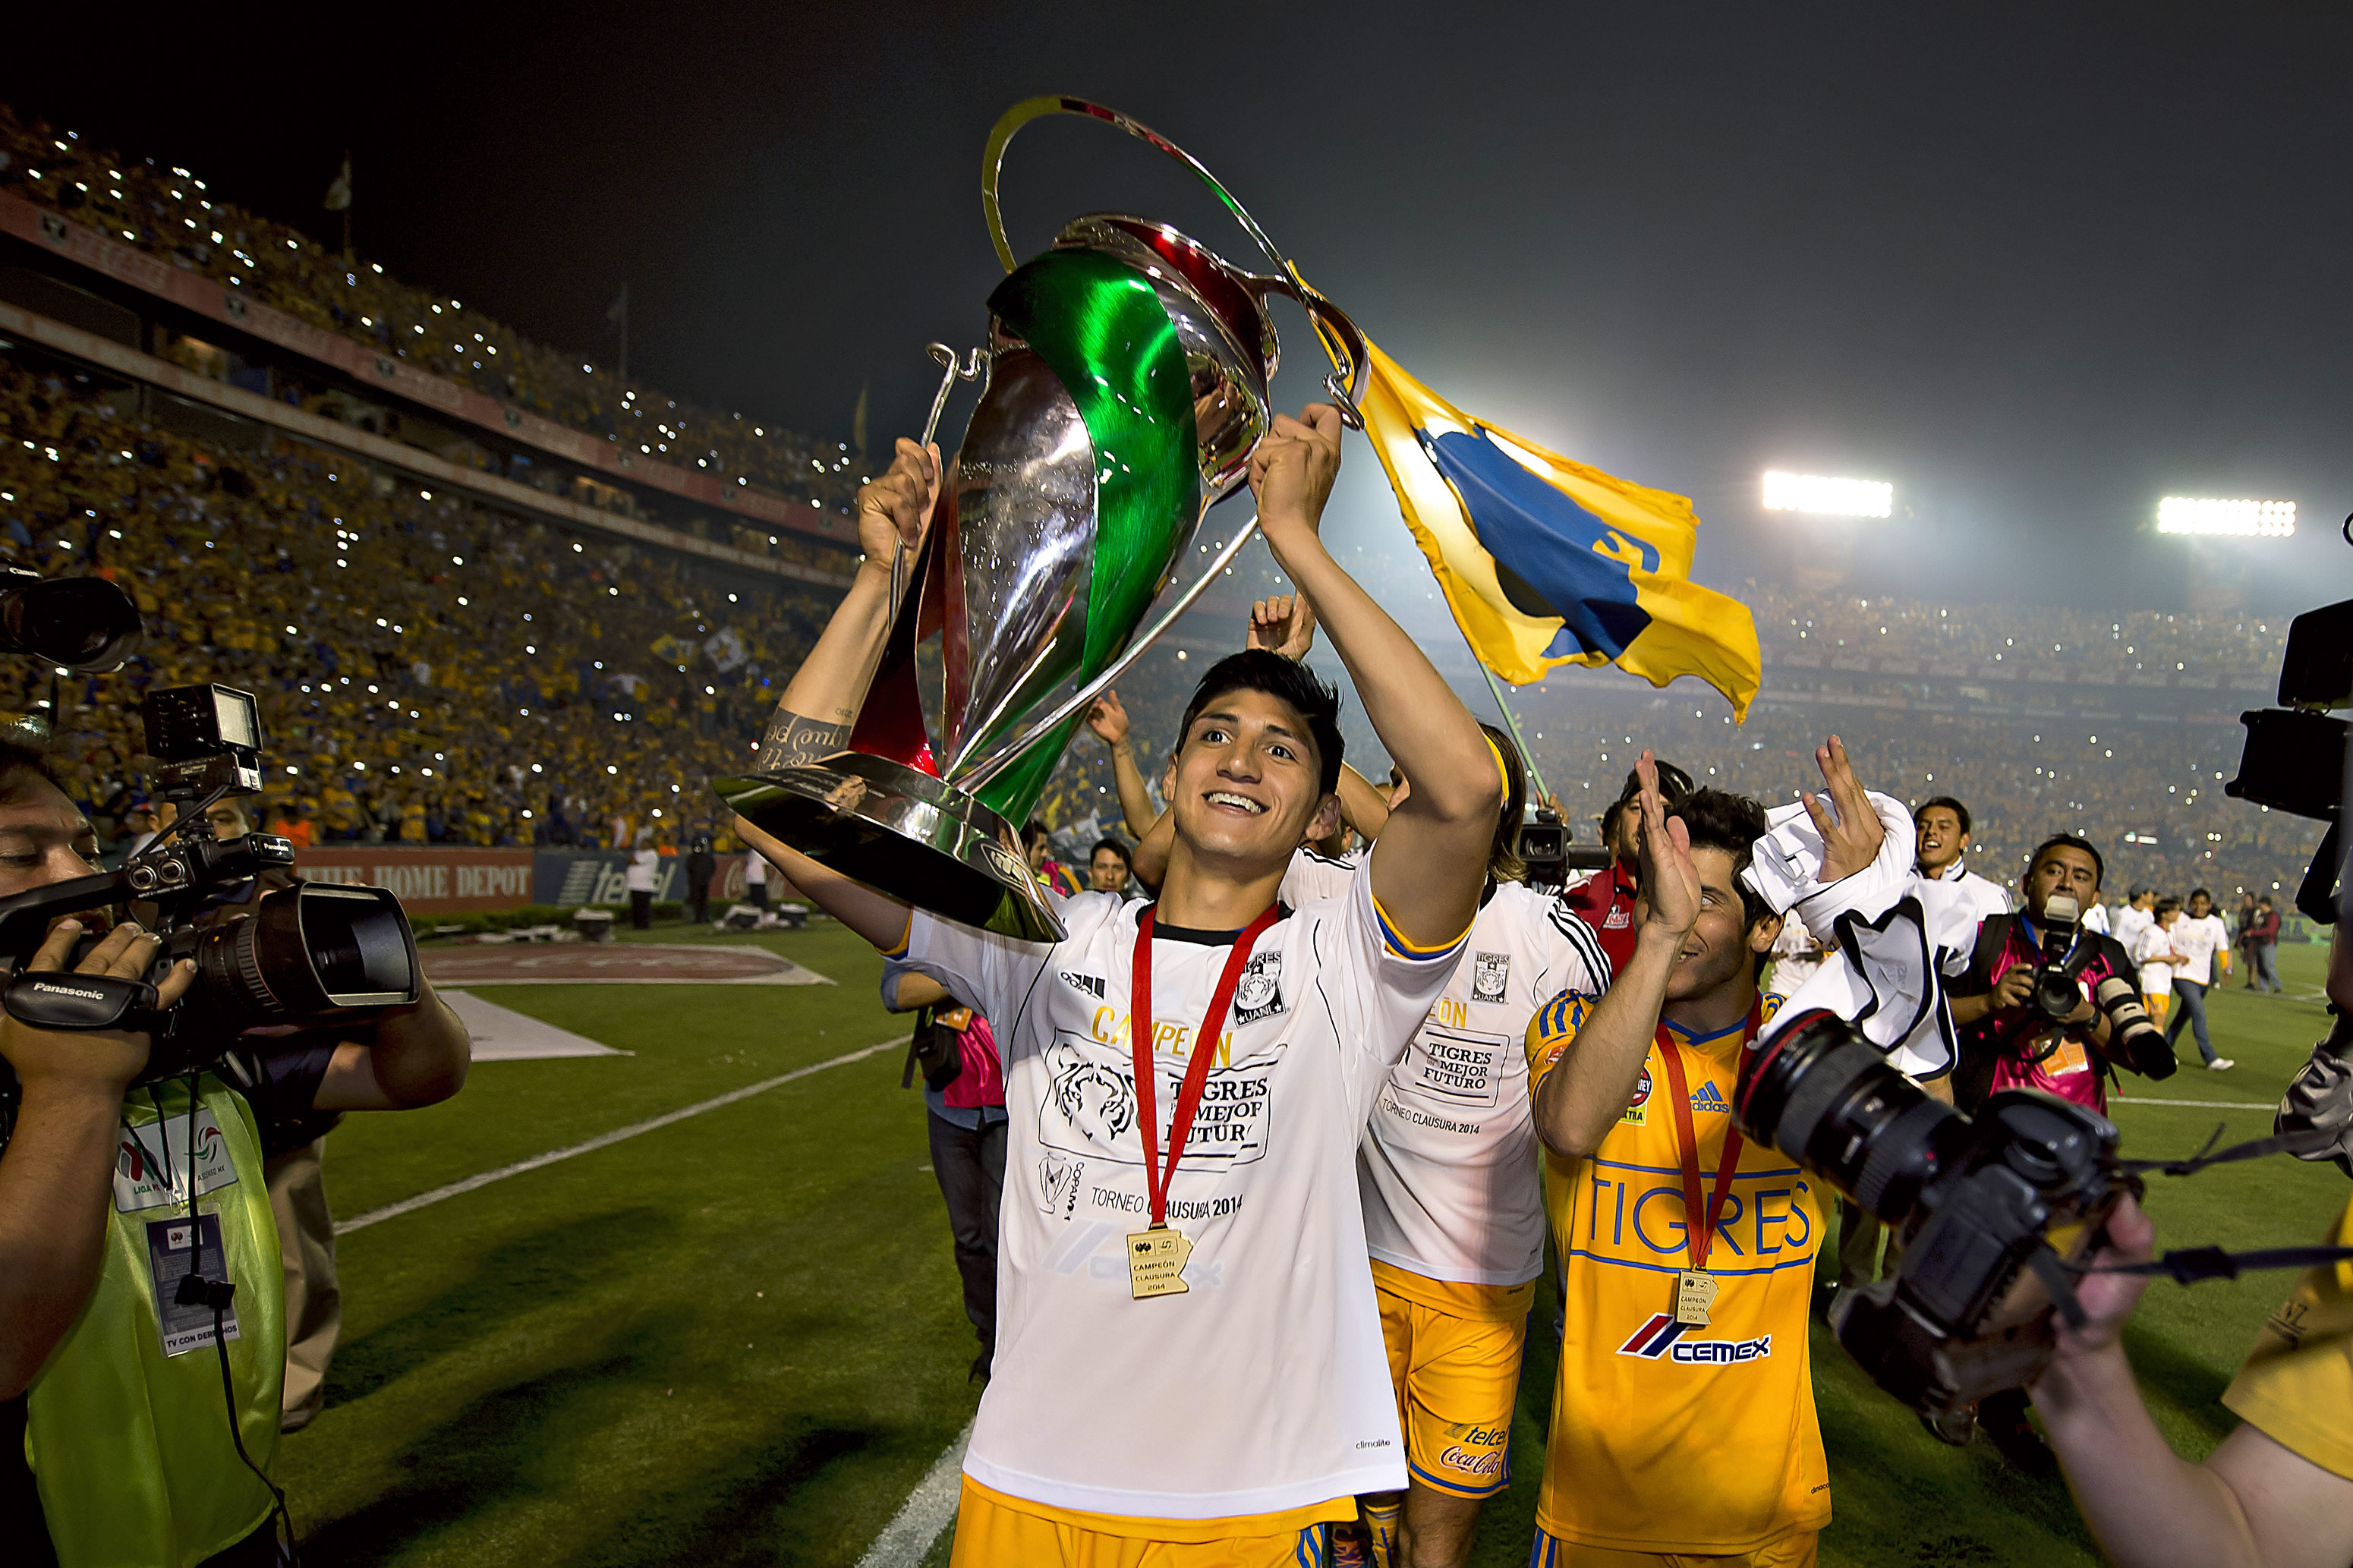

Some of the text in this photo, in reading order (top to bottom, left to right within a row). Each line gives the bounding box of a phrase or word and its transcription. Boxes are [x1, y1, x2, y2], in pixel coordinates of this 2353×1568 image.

[373, 865, 451, 899] HOME
[457, 865, 530, 897] DEPOT
[1477, 952, 1510, 964] TIGRES
[33, 983, 104, 1000] Panasonic
[1479, 993, 1498, 1002] UANL
[1244, 1003, 1275, 1022] UANL
[1091, 1006, 1232, 1069] CAPEN
[1428, 1043, 1493, 1065] TIGRES
[1422, 1066, 1486, 1089] FUTURO
[1440, 1060, 1488, 1077] MEJOR
[1170, 1077, 1268, 1100] TGRES
[1690, 1100, 1730, 1113] didas
[1382, 1098, 1480, 1135] TORNEO CLAUSURA 2014
[134, 1185, 152, 1195] LIGA
[1091, 1186, 1144, 1213] TORNEO
[1213, 1193, 1243, 1216] 2014
[1136, 1271, 1176, 1282] CLAUSURA
[1148, 1283, 1165, 1291] 2014
[166, 1324, 238, 1348] TV CON DERHOS
[1672, 1336, 1770, 1363] CEMEX
[1356, 1437, 1391, 1450] climalite
